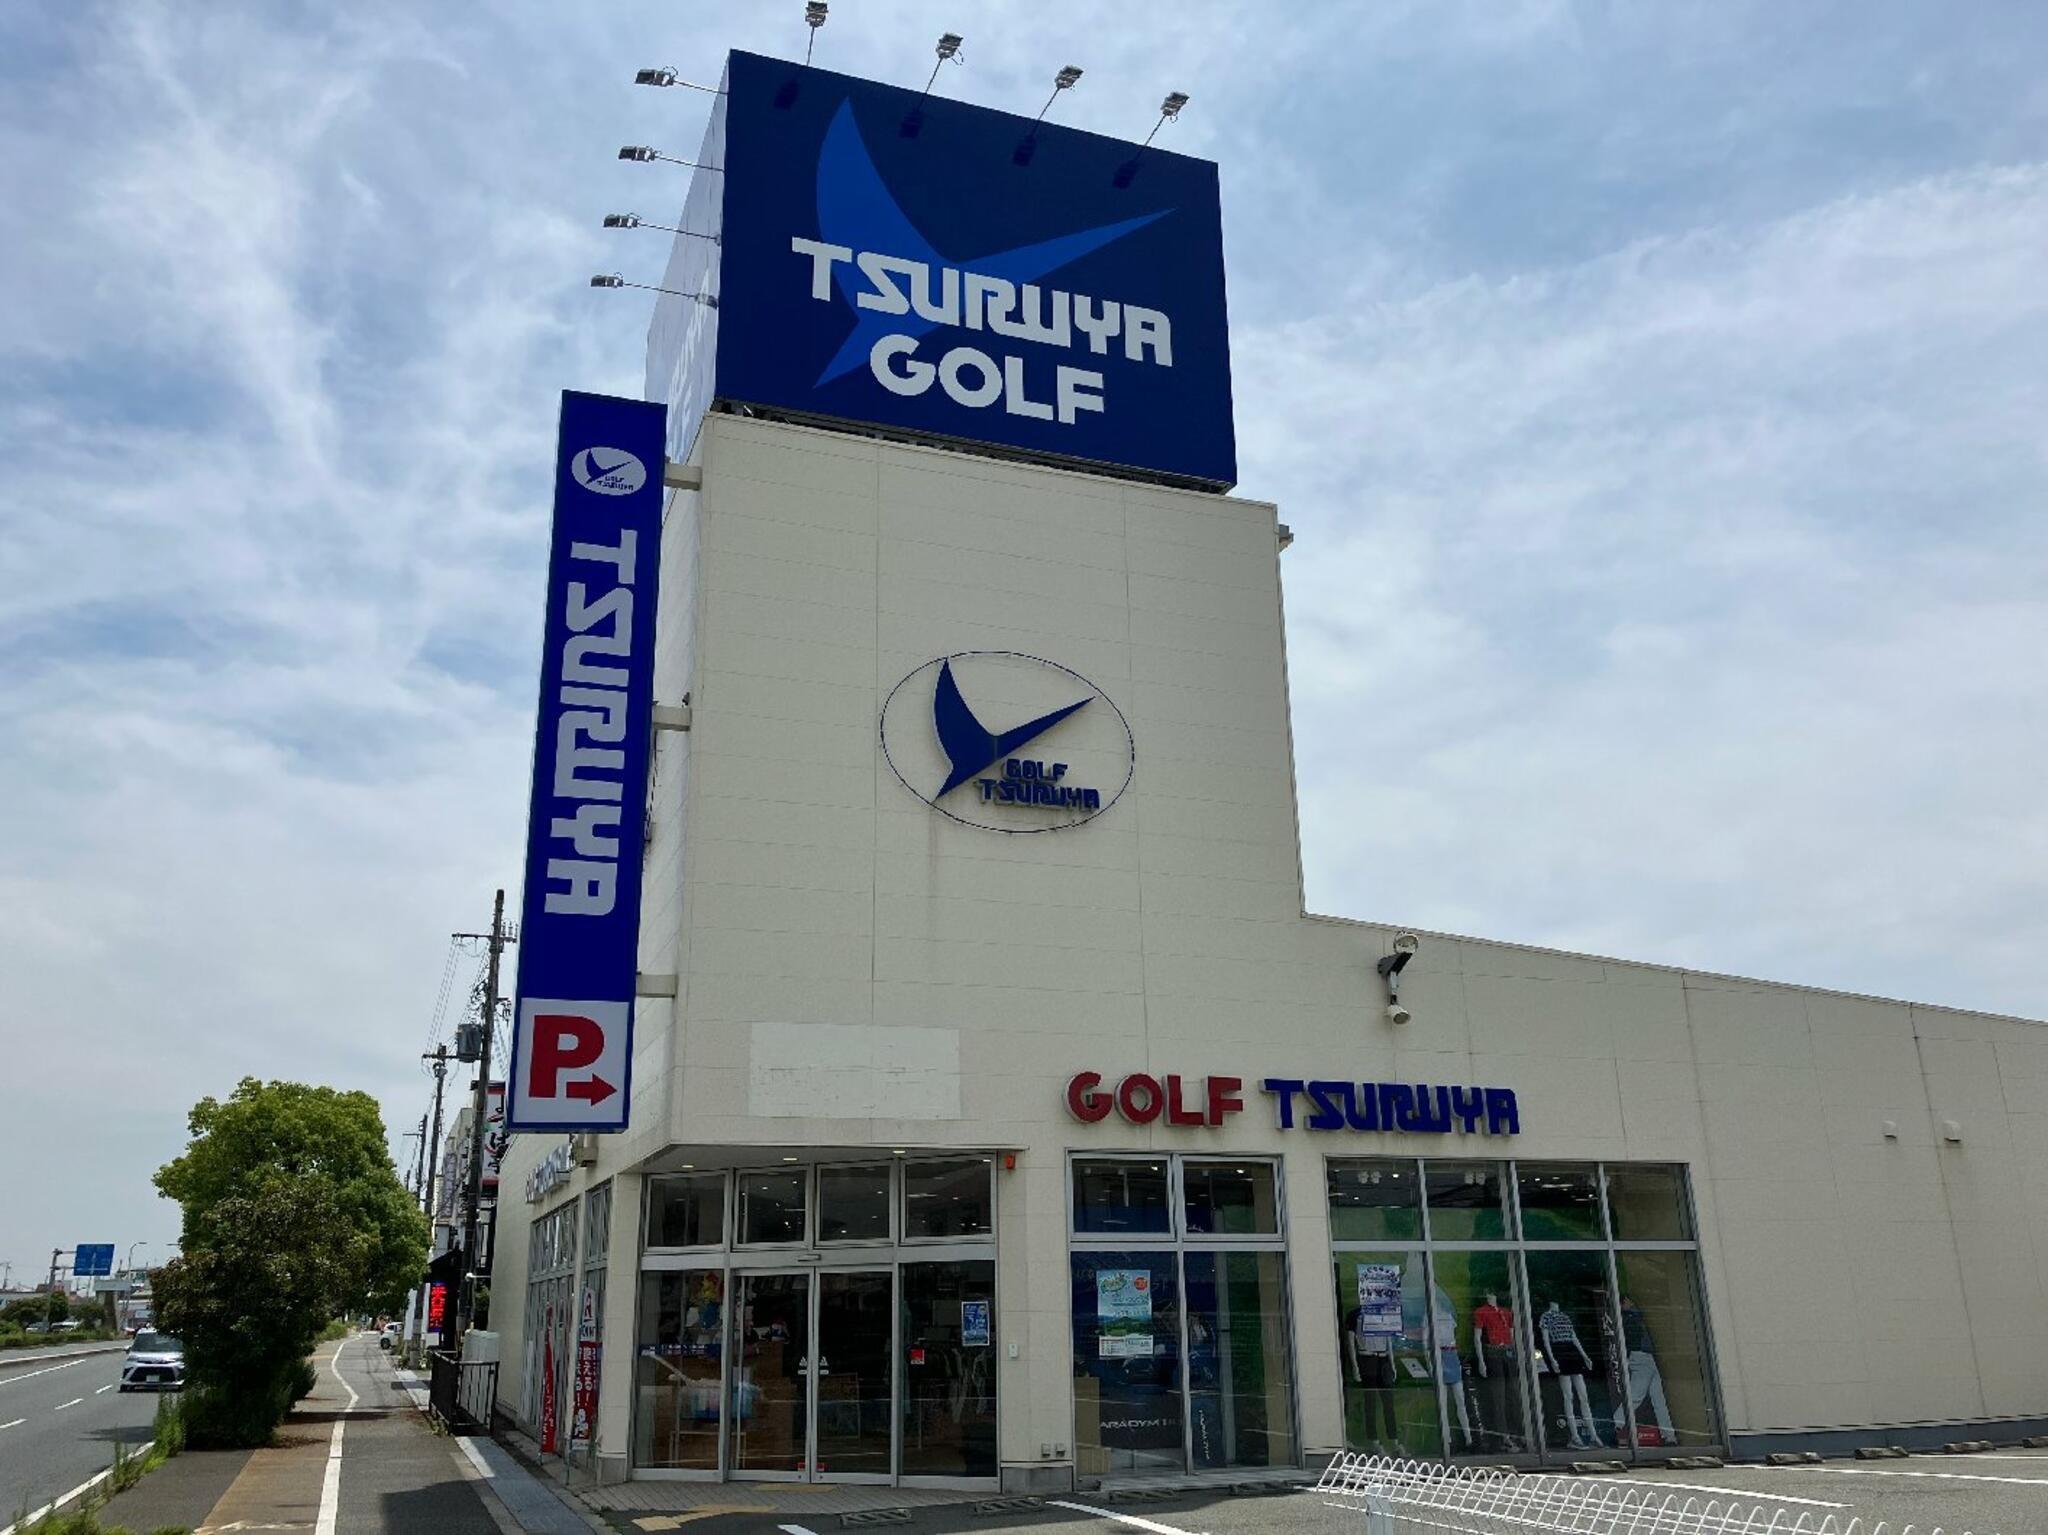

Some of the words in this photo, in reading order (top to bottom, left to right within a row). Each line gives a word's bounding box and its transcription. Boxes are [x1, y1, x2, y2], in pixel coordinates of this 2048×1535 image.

[792, 237, 1173, 367] TSURUYA
[869, 334, 1105, 425] GOLF
[544, 529, 637, 916] TSURUYA
[978, 778, 1100, 811] TSURUYA
[1004, 758, 1068, 782] GOLF
[529, 1014, 605, 1099] P
[1066, 1071, 1243, 1127] GOLF
[1260, 1078, 1520, 1135] TSURUYA
